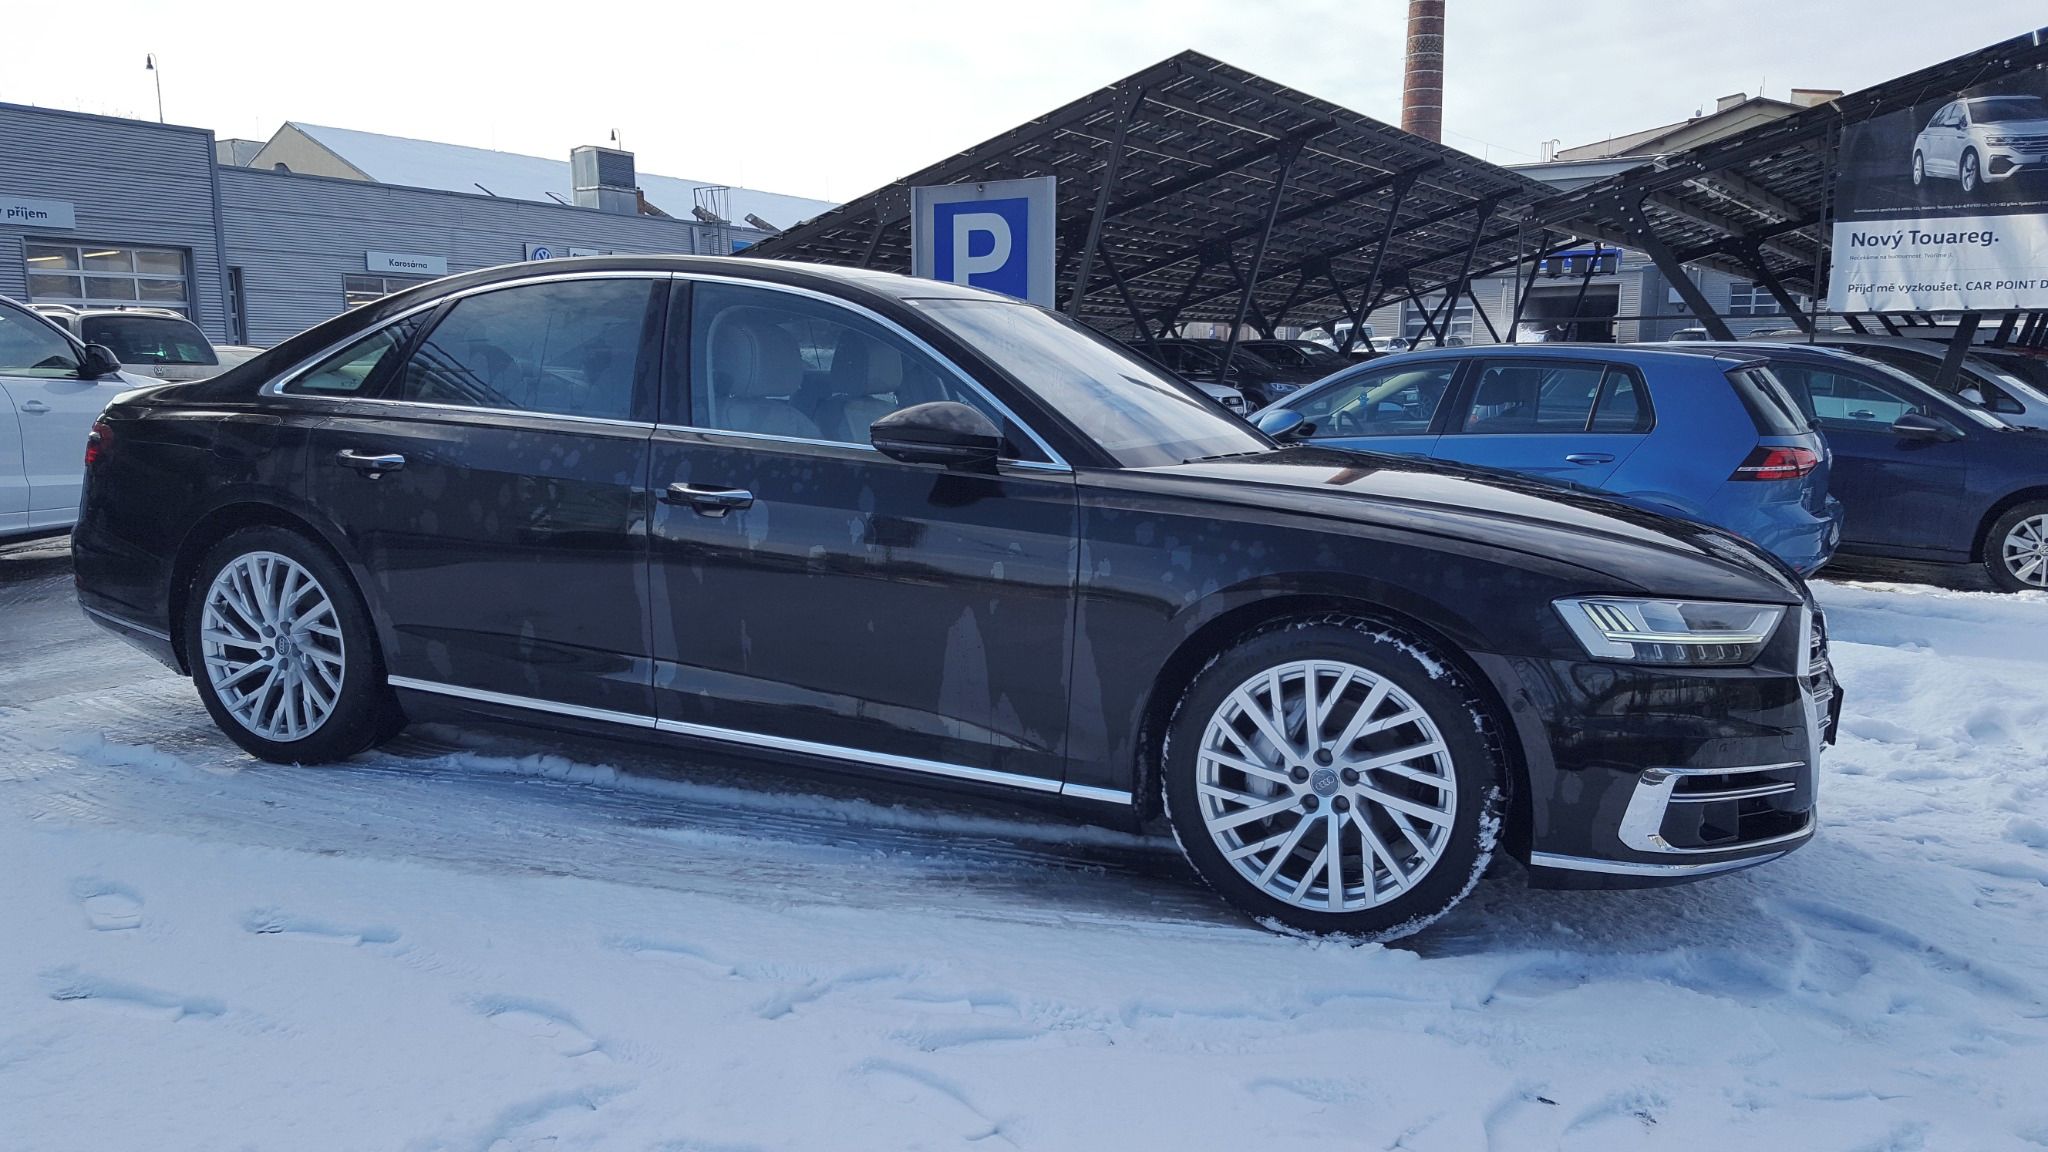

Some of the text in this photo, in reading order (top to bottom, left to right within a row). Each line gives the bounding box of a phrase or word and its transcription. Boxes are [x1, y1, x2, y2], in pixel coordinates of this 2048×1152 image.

[7, 206, 48, 220] příjem
[1851, 230, 1999, 249] Nový Touareg.
[953, 212, 1012, 287] P
[388, 258, 428, 269] Karosárna
[1876, 282, 1894, 292] mě
[1898, 280, 1962, 294] vyzkoušet.
[1966, 281, 1992, 291] CAR
[1995, 280, 2036, 290] POINT
